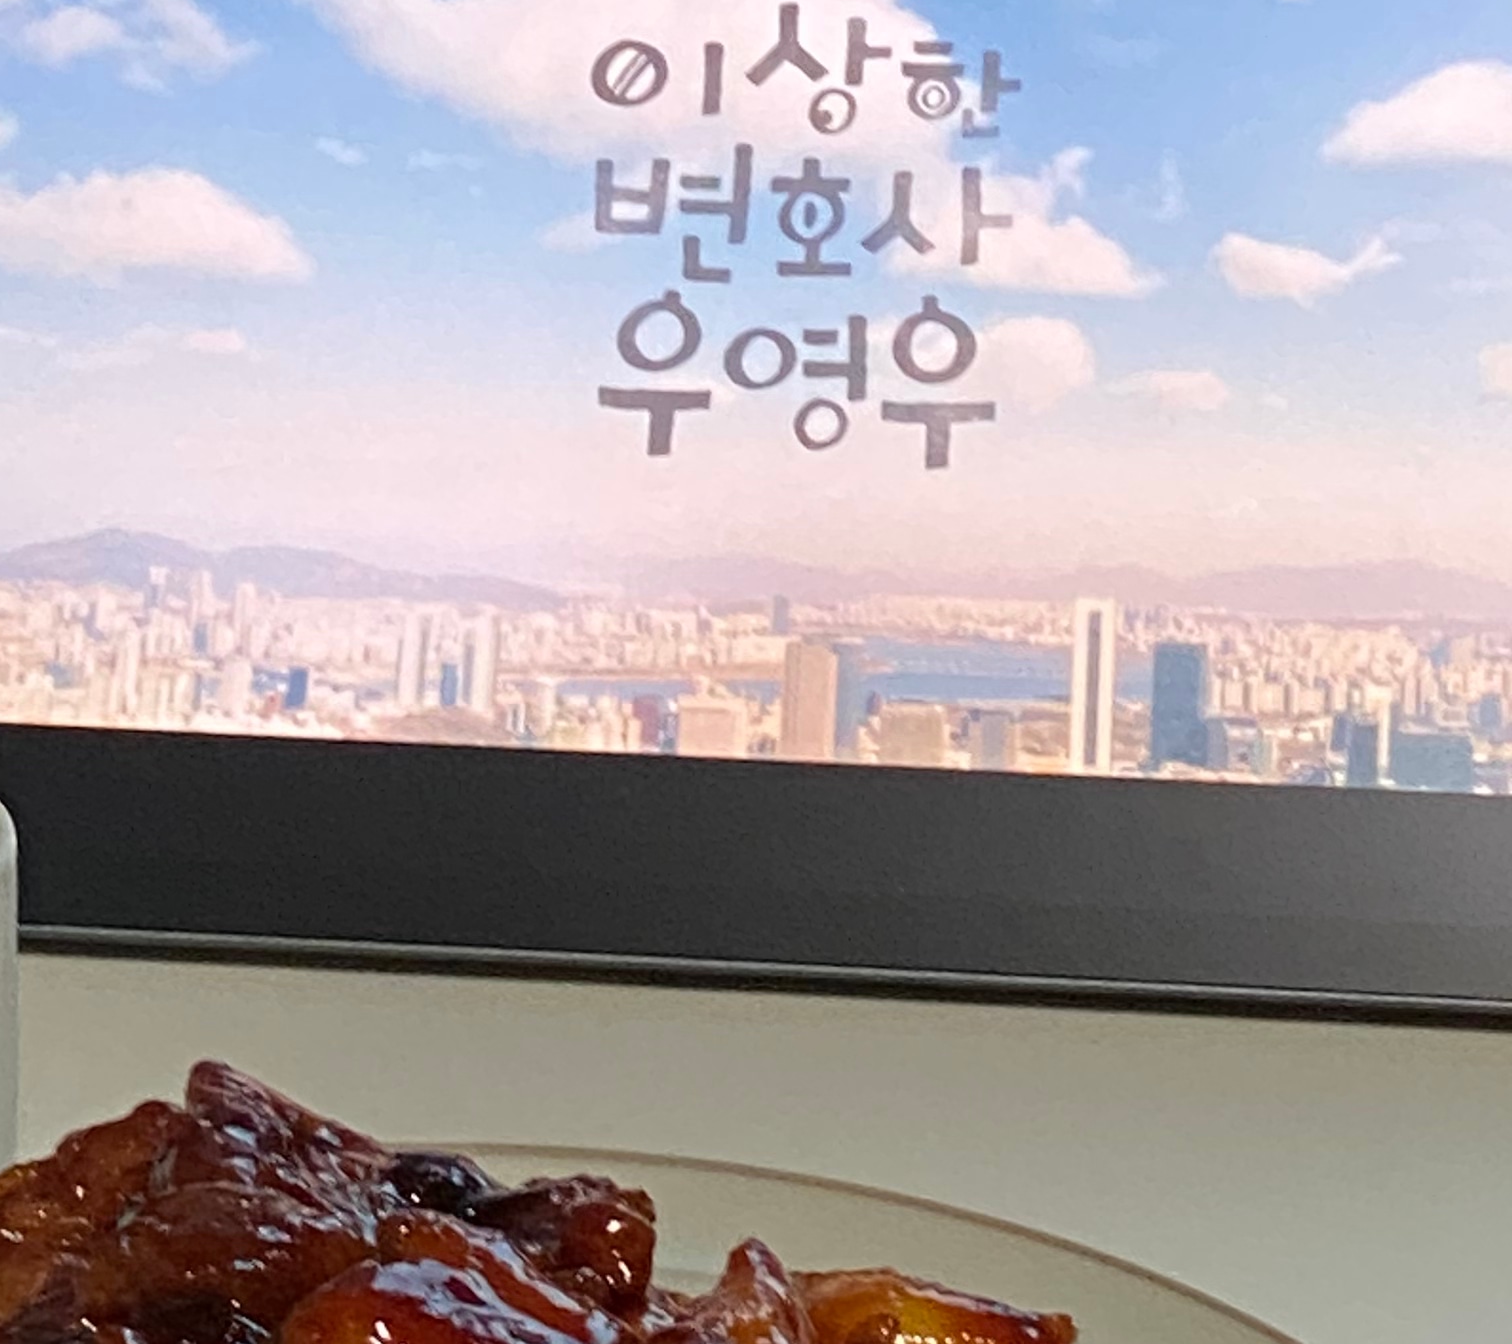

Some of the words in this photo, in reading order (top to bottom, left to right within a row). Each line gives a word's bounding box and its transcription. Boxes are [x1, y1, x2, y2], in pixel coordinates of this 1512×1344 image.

[591, 2, 1021, 138] 이상한
[595, 143, 1013, 283] 변호사
[598, 289, 996, 469] 우영우
